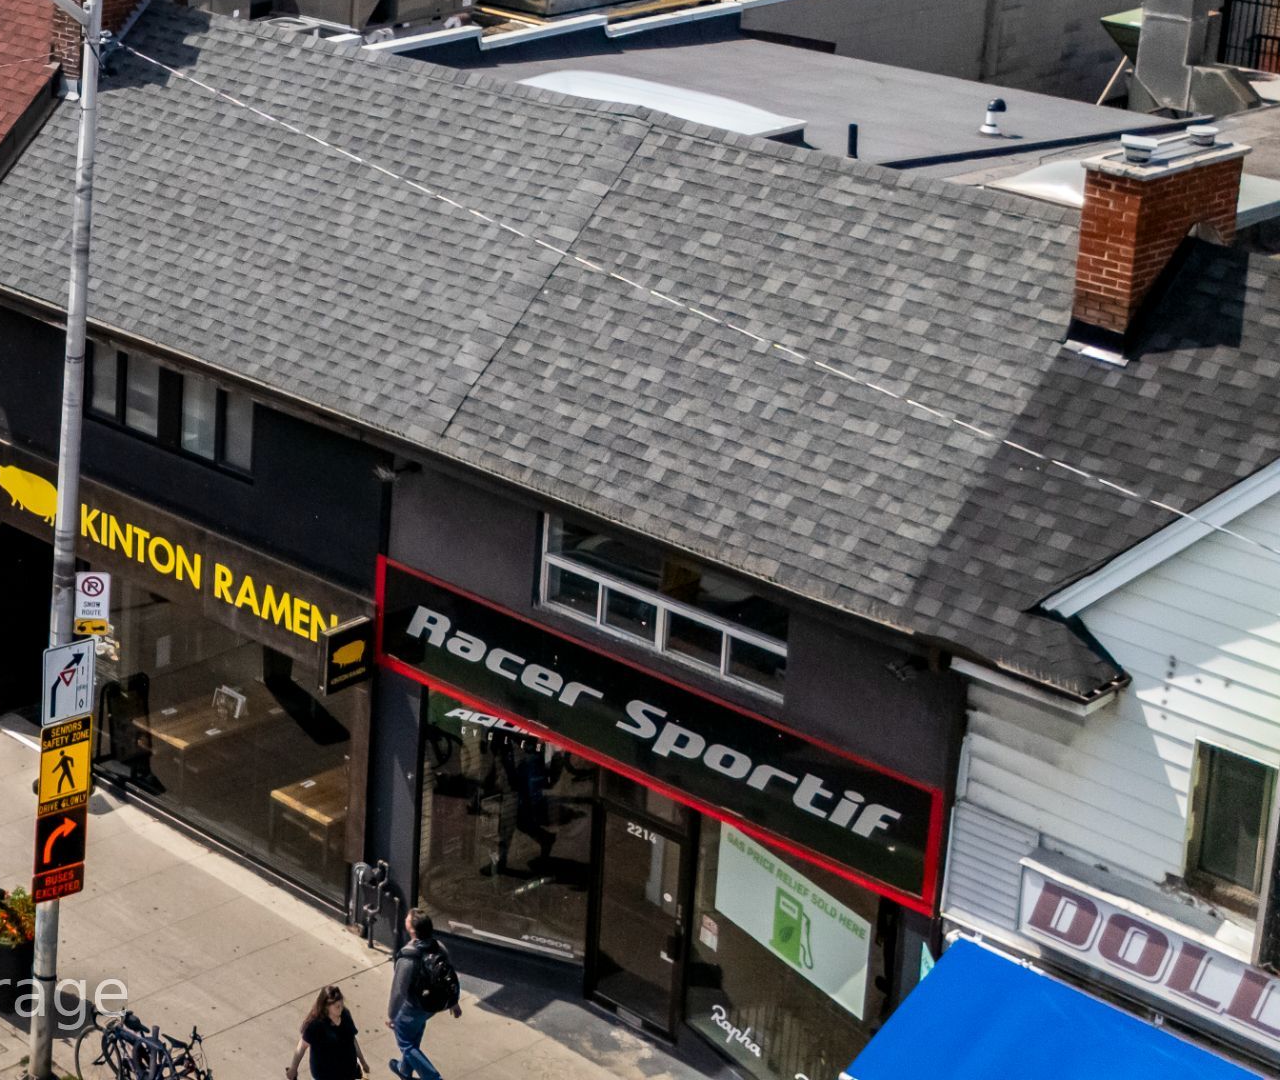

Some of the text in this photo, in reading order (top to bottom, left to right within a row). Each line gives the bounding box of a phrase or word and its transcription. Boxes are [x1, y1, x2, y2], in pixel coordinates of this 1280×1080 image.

[80, 503, 338, 642] KINTON RAMEN
[81, 608, 102, 617] ROUTE
[51, 720, 83, 738] SENIORS
[406, 605, 902, 838] Racer Sportif
[42, 728, 90, 750] SAFETY ZONE
[38, 801, 59, 817] DRIVE
[627, 822, 658, 845] 2214
[45, 869, 75, 886] BUSES
[35, 879, 80, 899] EXCEPTED
[776, 868, 810, 897] RELIEF
[811, 893, 838, 919] SOLD
[838, 912, 866, 940] HERE
[711, 1004, 761, 1057] Rapha
